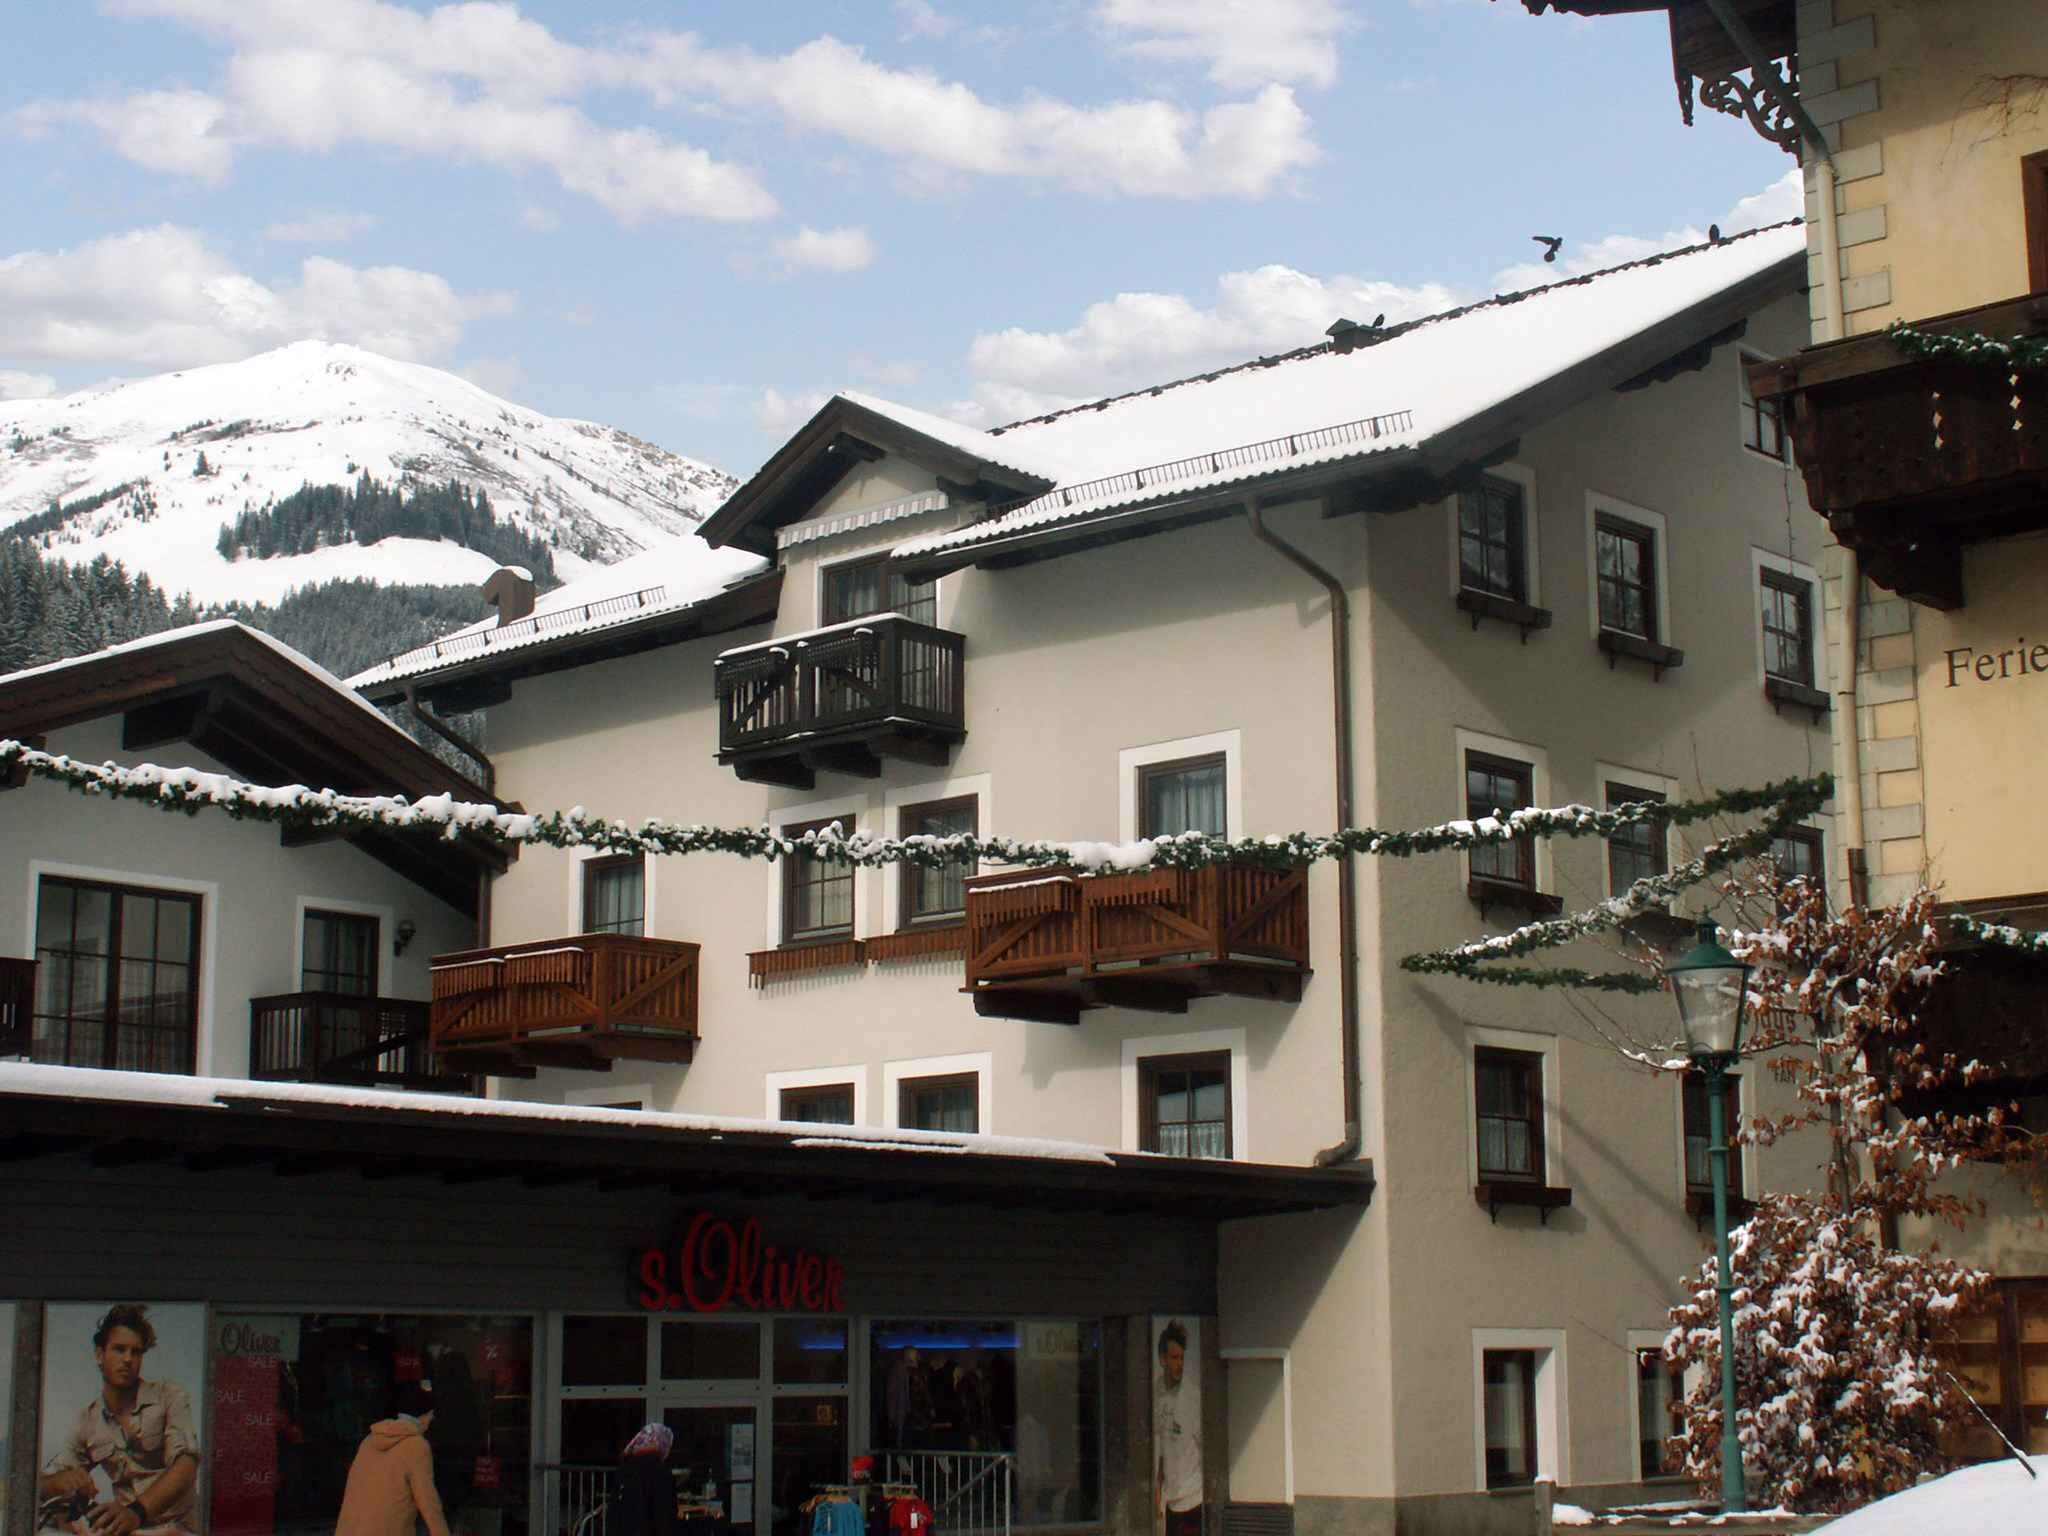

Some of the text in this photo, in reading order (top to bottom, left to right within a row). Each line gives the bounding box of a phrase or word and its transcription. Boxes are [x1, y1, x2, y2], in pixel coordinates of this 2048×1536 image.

[1944, 637, 2048, 688] Ferie
[640, 1211, 846, 1312] s.Oliver
[215, 1390, 244, 1403] SALE
[245, 1413, 273, 1426] SALE
[242, 1472, 273, 1485] SALE
